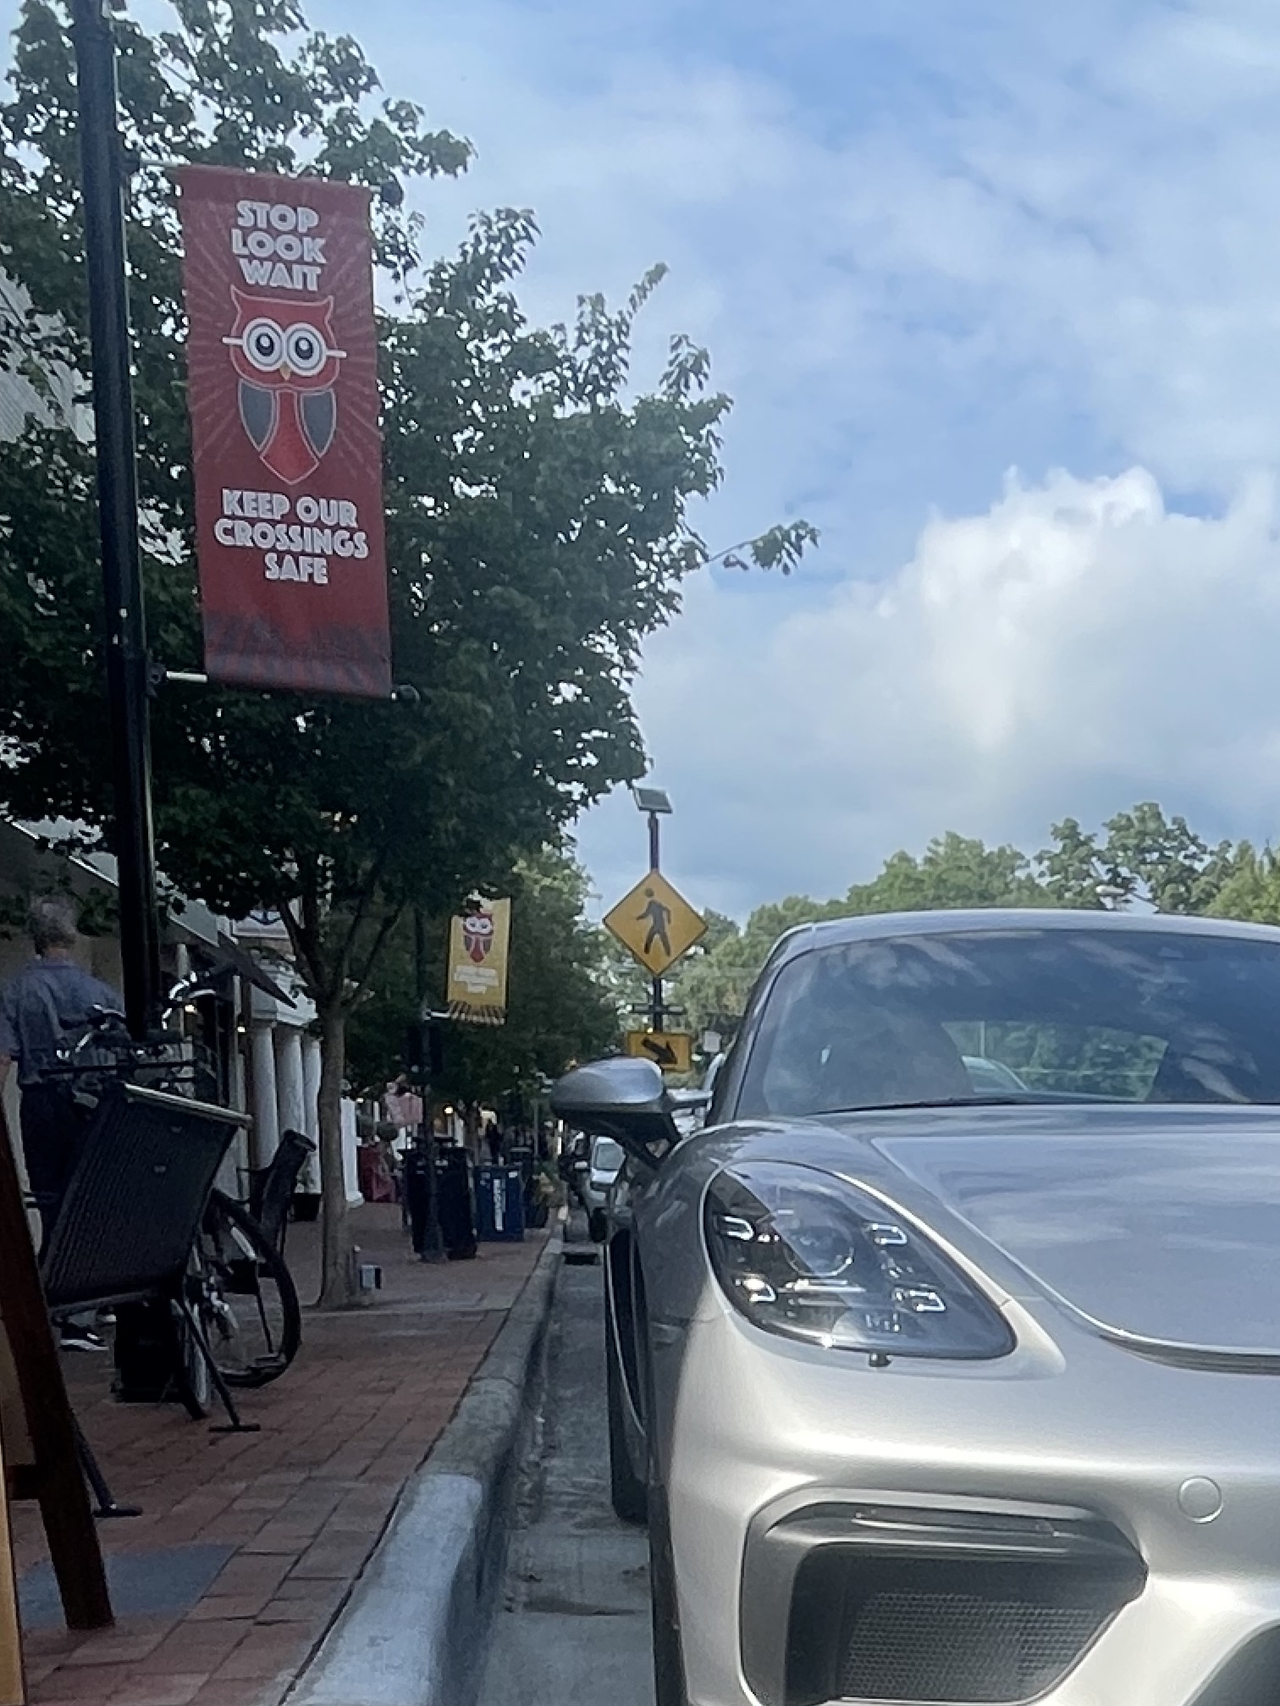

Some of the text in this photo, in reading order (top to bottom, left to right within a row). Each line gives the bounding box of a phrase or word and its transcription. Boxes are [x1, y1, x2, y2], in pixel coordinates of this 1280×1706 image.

[237, 200, 319, 233] STOP
[231, 228, 327, 263] LOOK
[239, 258, 321, 291] WAIT
[222, 488, 358, 527] KEEP OUR
[214, 518, 369, 559] CROSSINGS
[264, 552, 328, 584] SAFE
